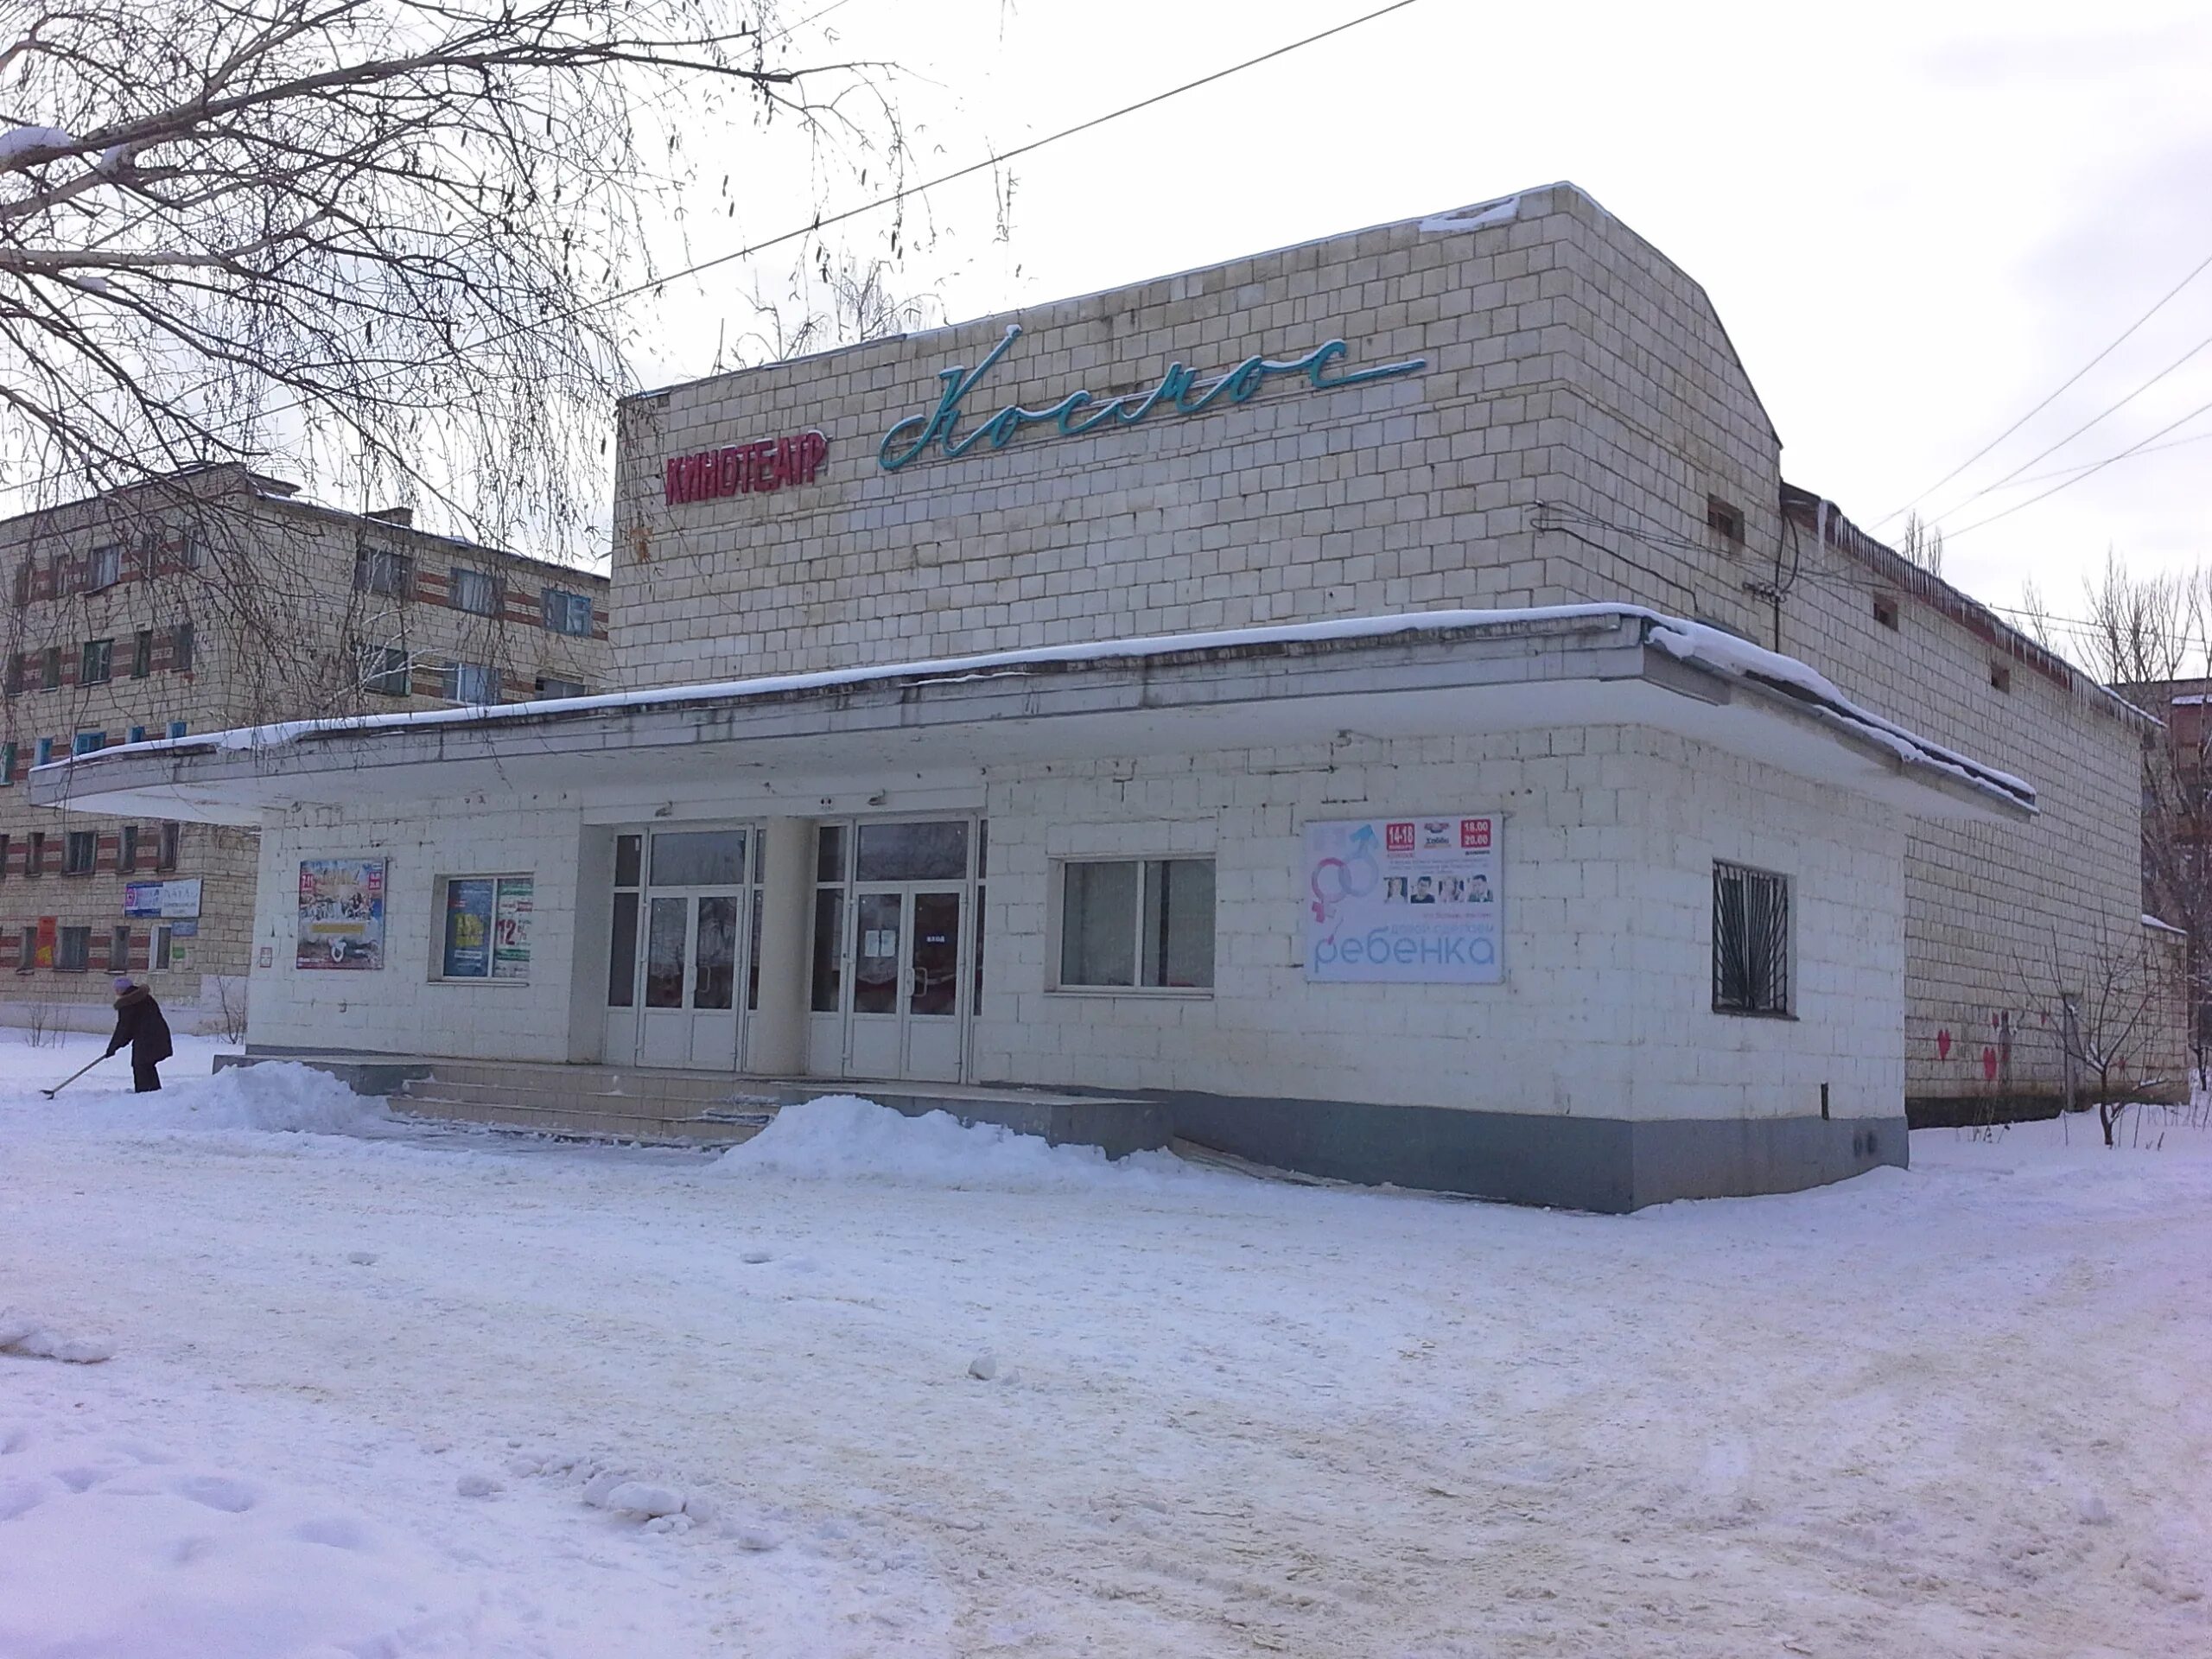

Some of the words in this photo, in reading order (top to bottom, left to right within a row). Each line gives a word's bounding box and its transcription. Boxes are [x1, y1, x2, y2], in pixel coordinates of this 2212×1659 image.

[879, 324, 1428, 470] Космос
[666, 430, 829, 505] КИНОТЕАТР
[1389, 826, 1414, 844] 14-18
[1465, 822, 1489, 832] 18.00
[1465, 835, 1489, 845] 20.00
[497, 918, 517, 946] 12
[1314, 926, 1495, 973] ребенка
